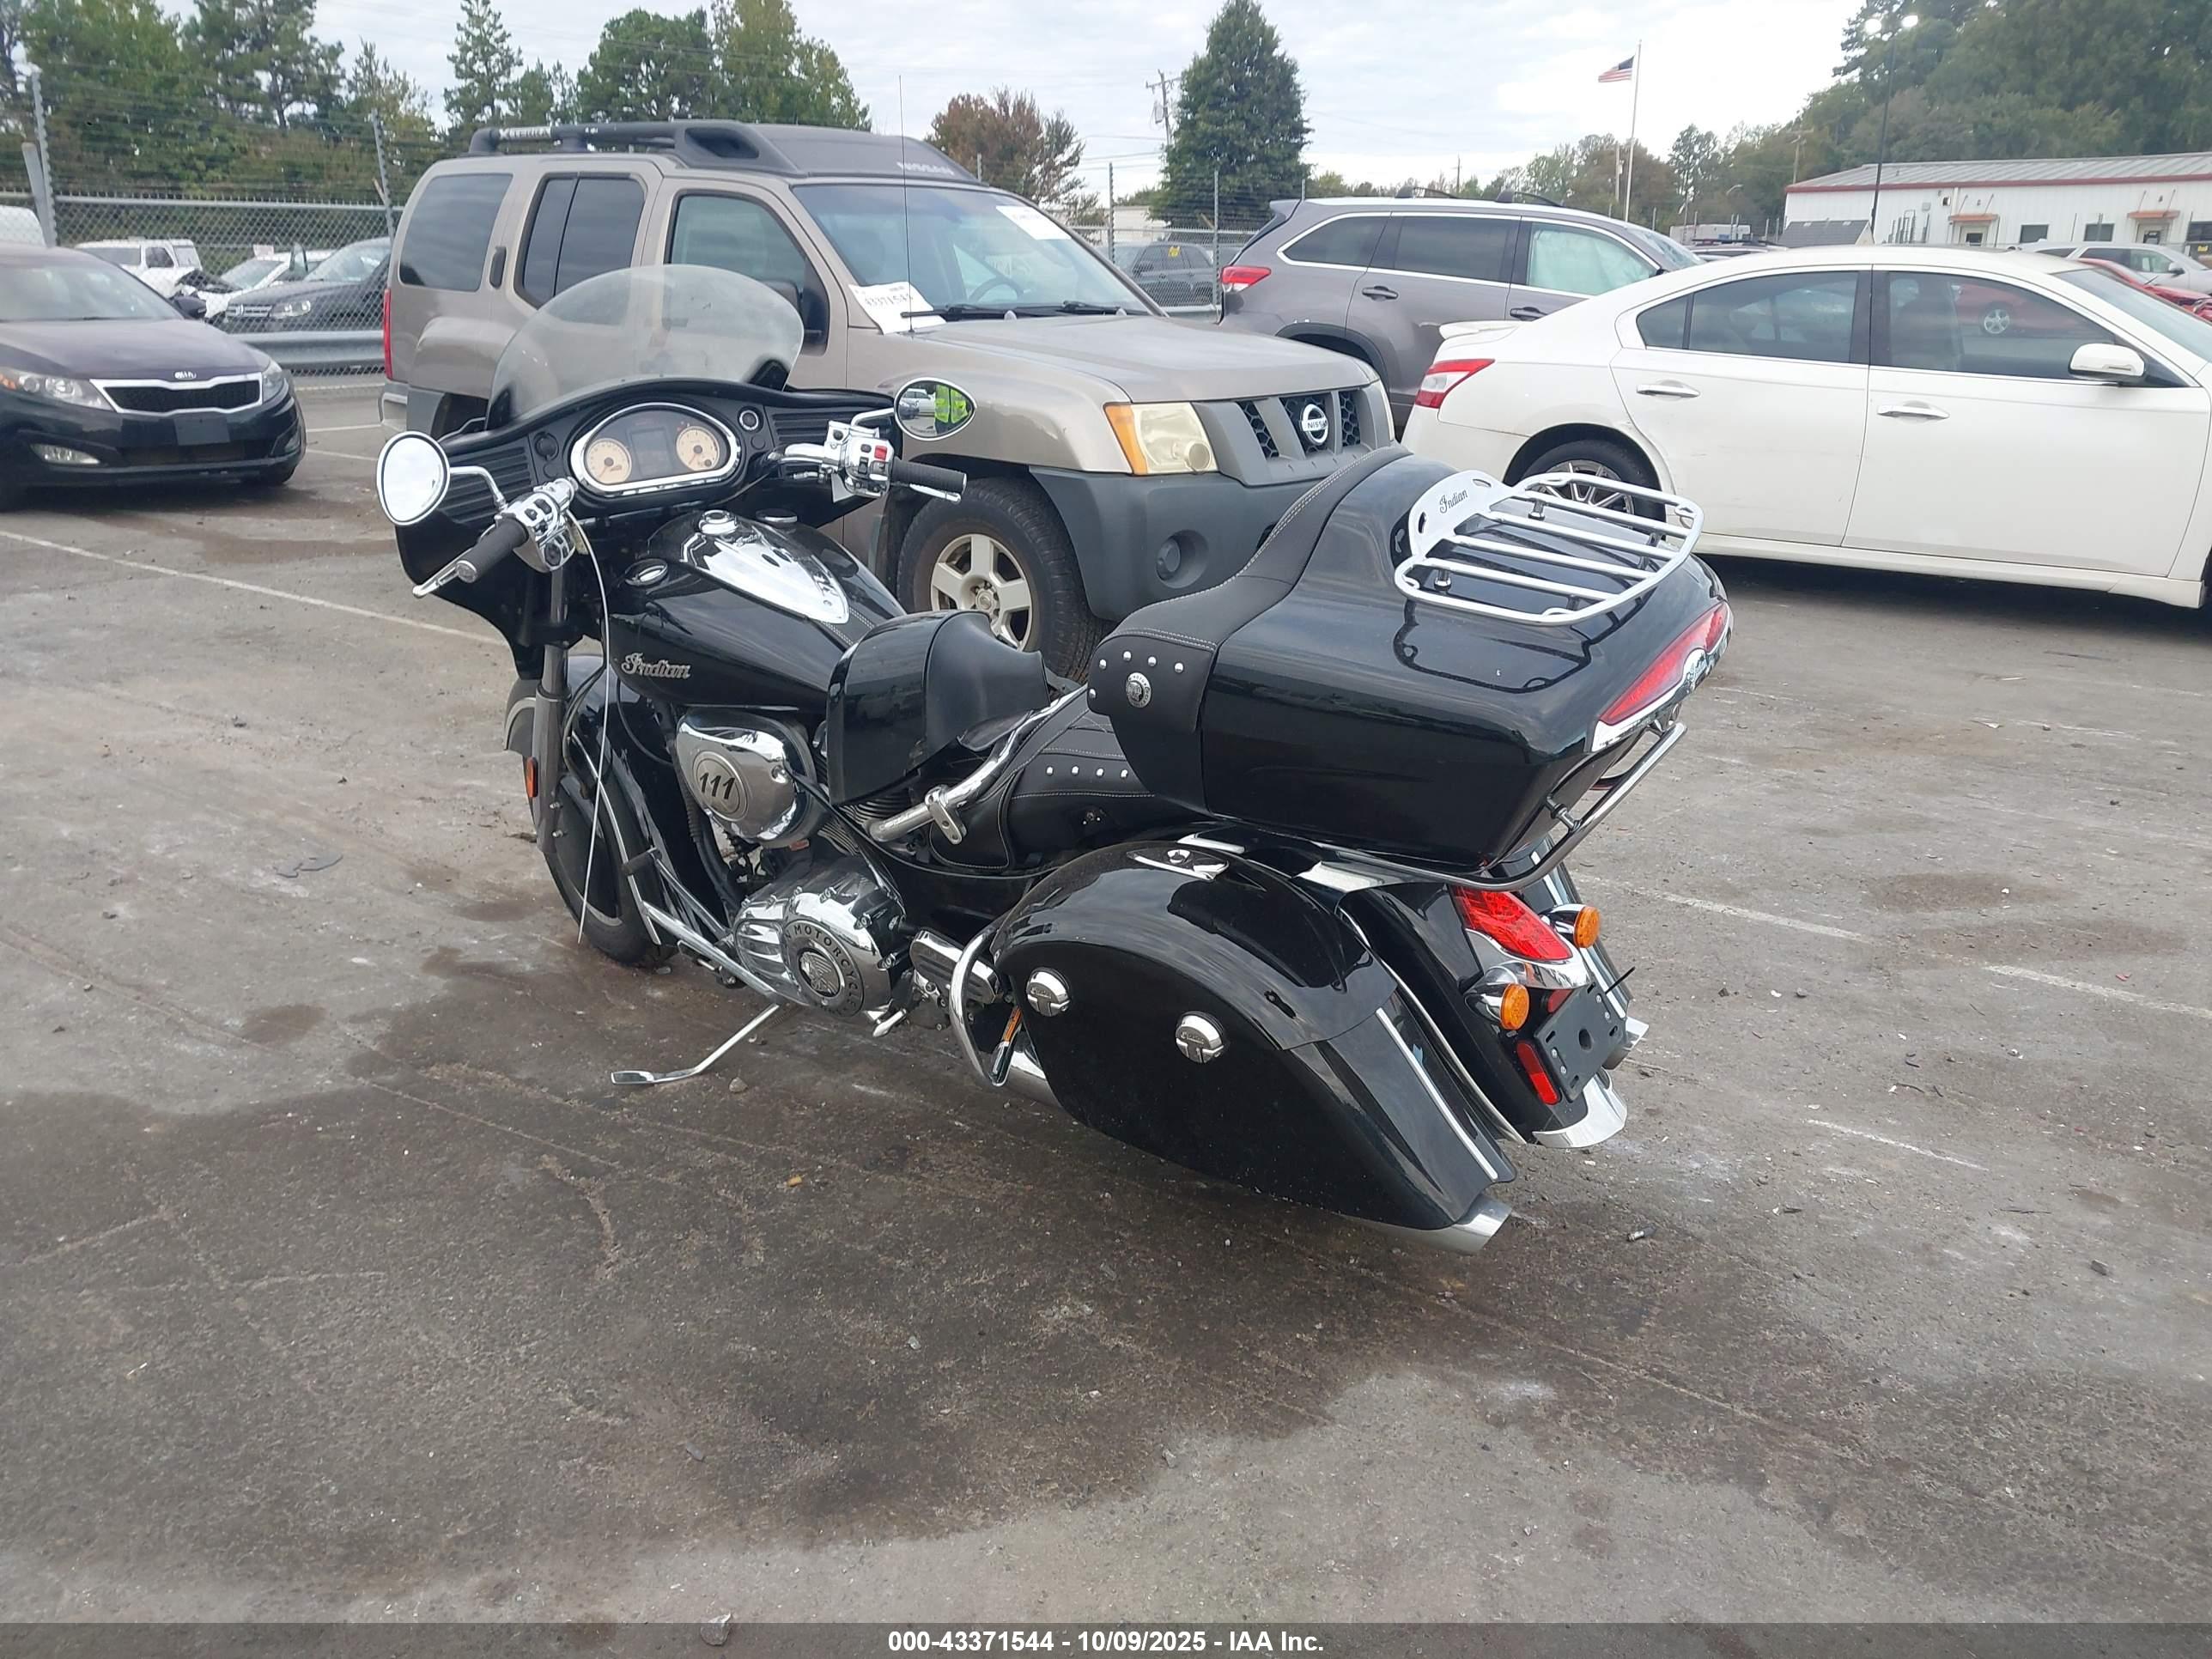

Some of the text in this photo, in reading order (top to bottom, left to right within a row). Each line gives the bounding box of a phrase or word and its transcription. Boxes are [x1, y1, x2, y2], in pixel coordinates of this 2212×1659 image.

[1439, 489, 1468, 514] Indian
[621, 653, 690, 679] Indian
[699, 772, 736, 800] 111
